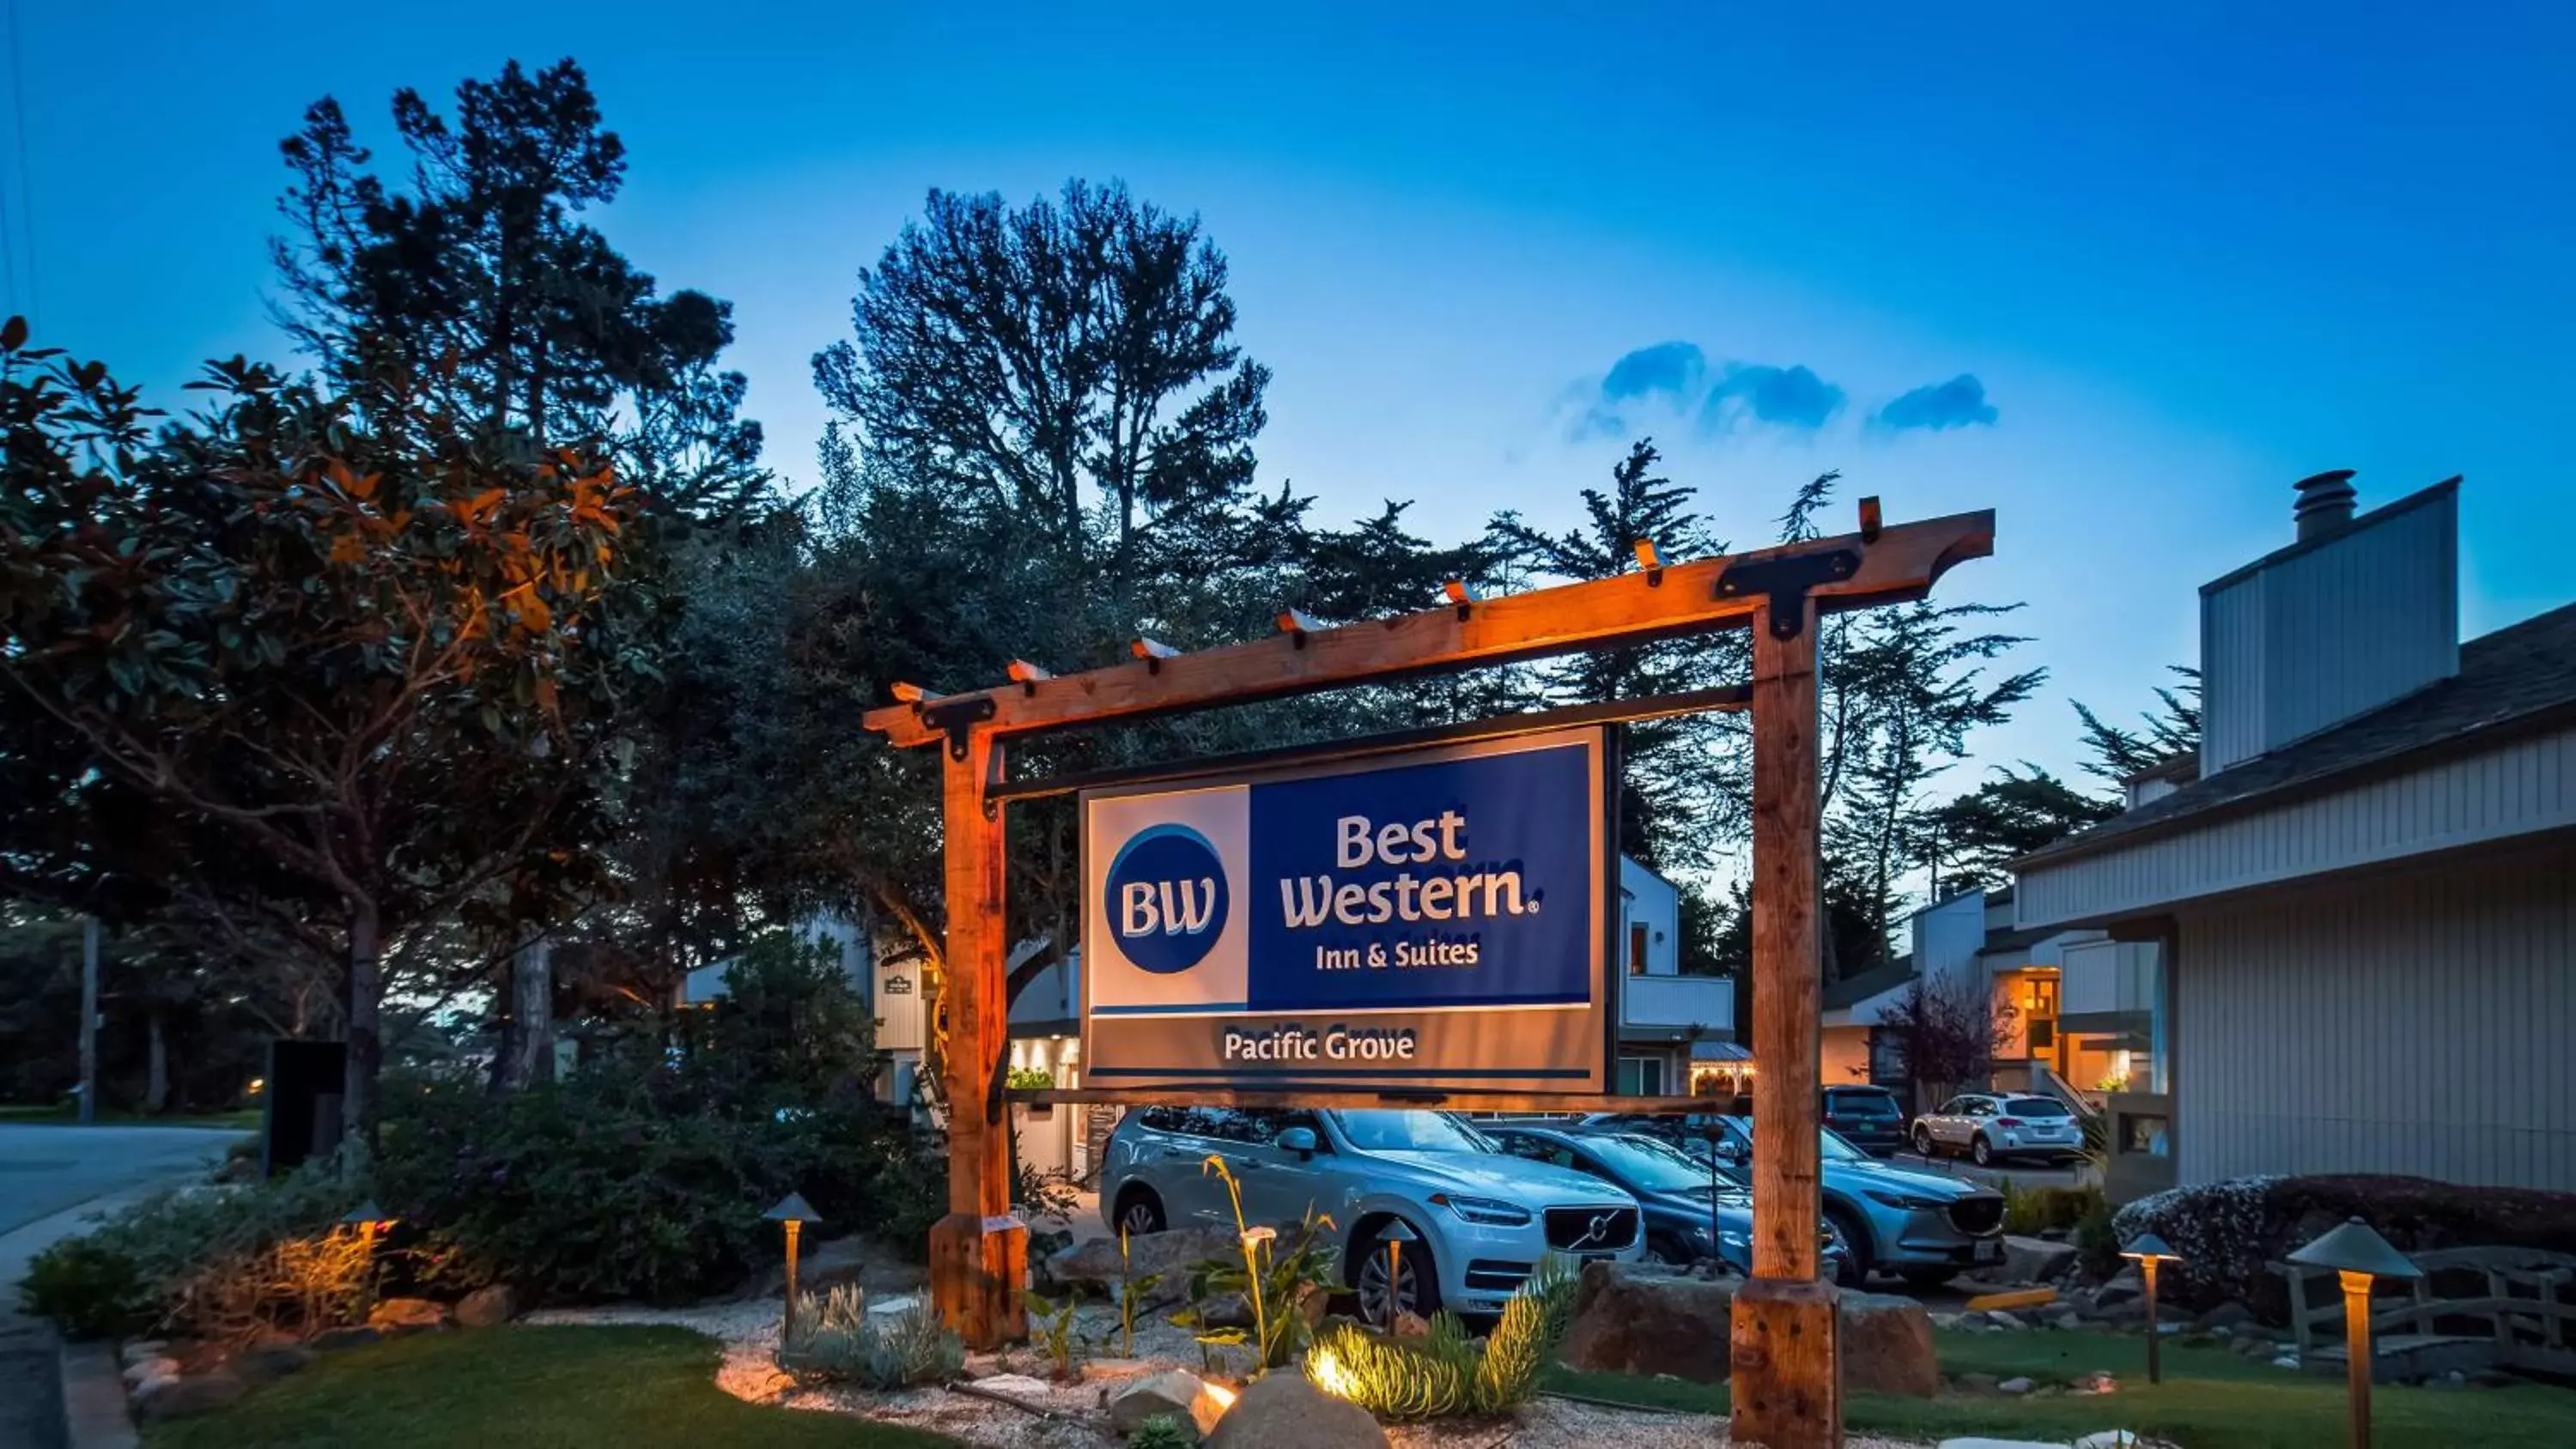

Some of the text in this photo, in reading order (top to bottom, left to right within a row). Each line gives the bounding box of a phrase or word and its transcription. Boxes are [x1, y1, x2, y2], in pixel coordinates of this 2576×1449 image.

[1337, 809, 1467, 869] Best
[1122, 877, 1216, 938] BW
[1279, 870, 1524, 929] Western
[1315, 939, 1479, 970] Inn & Suites
[1224, 1031, 1415, 1060] Pacific Grove
